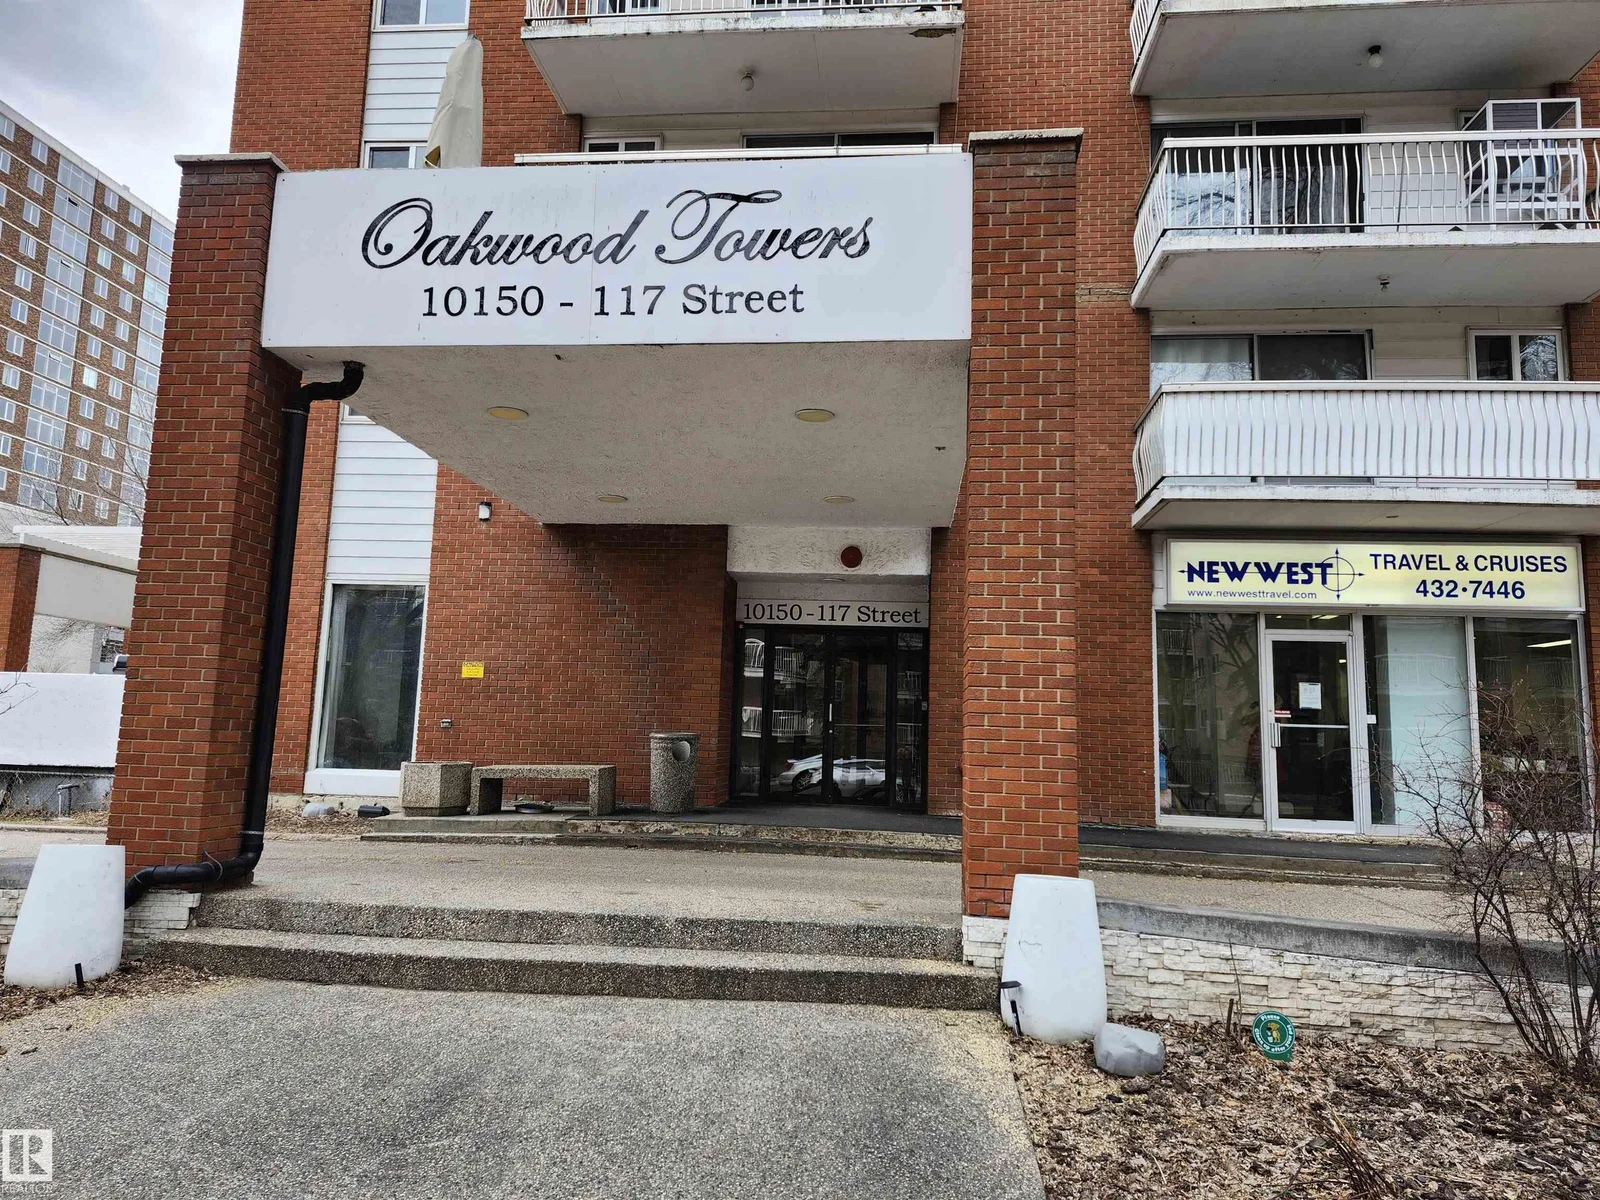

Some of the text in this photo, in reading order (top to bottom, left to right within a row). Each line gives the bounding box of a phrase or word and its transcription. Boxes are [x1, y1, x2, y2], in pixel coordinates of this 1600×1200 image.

[361, 189, 874, 270] Oakwood Towers
[422, 284, 544, 317] 10150
[594, 285, 666, 317] 117
[682, 283, 806, 316] Street
[1369, 553, 1568, 573] TRAVEL & CRUISES
[1187, 589, 1317, 599] www.newwesttravel.com
[743, 603, 803, 621] 10150
[817, 604, 851, 622] 117
[857, 605, 922, 624] Street
